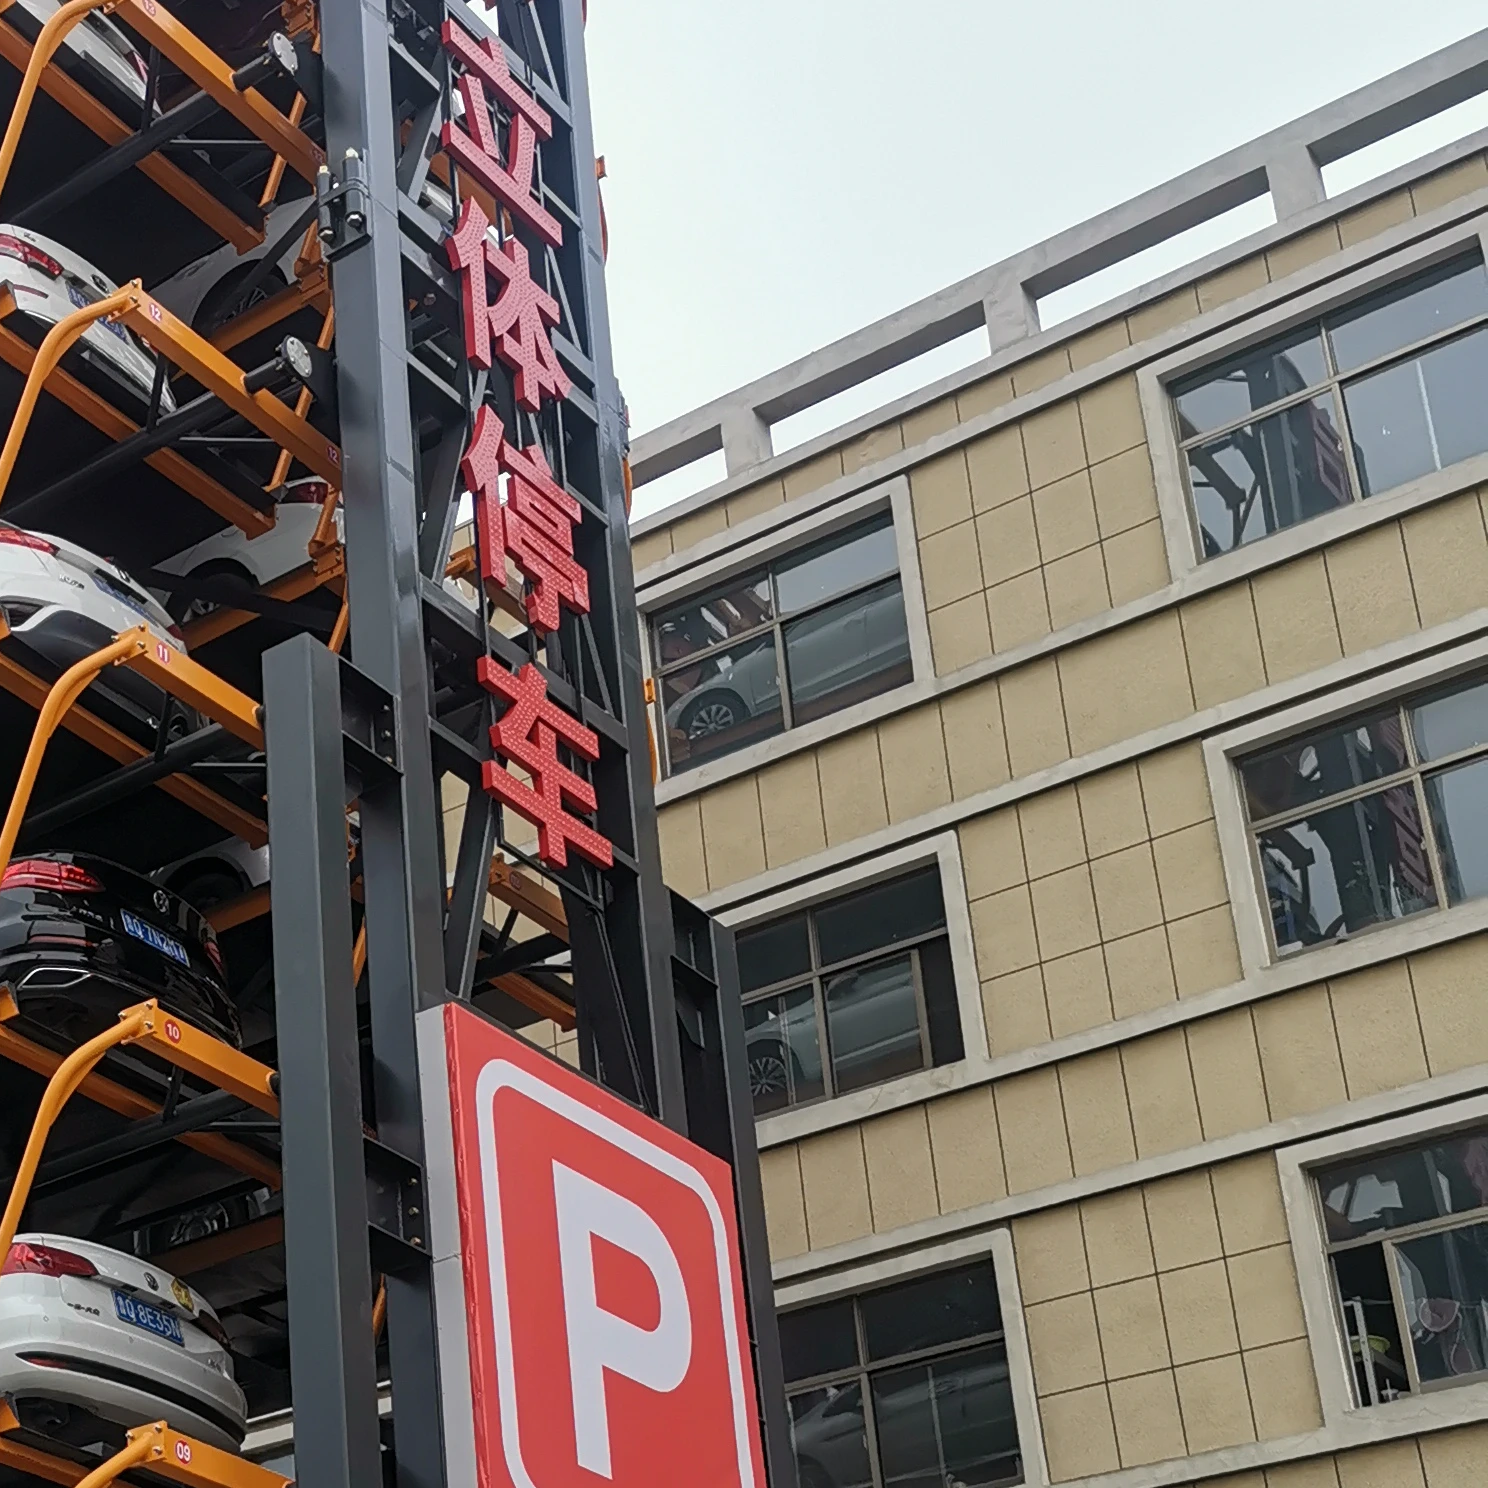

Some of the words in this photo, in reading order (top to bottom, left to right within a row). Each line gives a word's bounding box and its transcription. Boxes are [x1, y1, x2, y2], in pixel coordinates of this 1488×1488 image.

[149, 303, 161, 322] 12
[441, 18, 613, 869] 立体停车
[158, 643, 169, 663] 11
[166, 1023, 180, 1040] 10
[551, 1158, 693, 1480] P
[176, 1441, 191, 1462] 09
